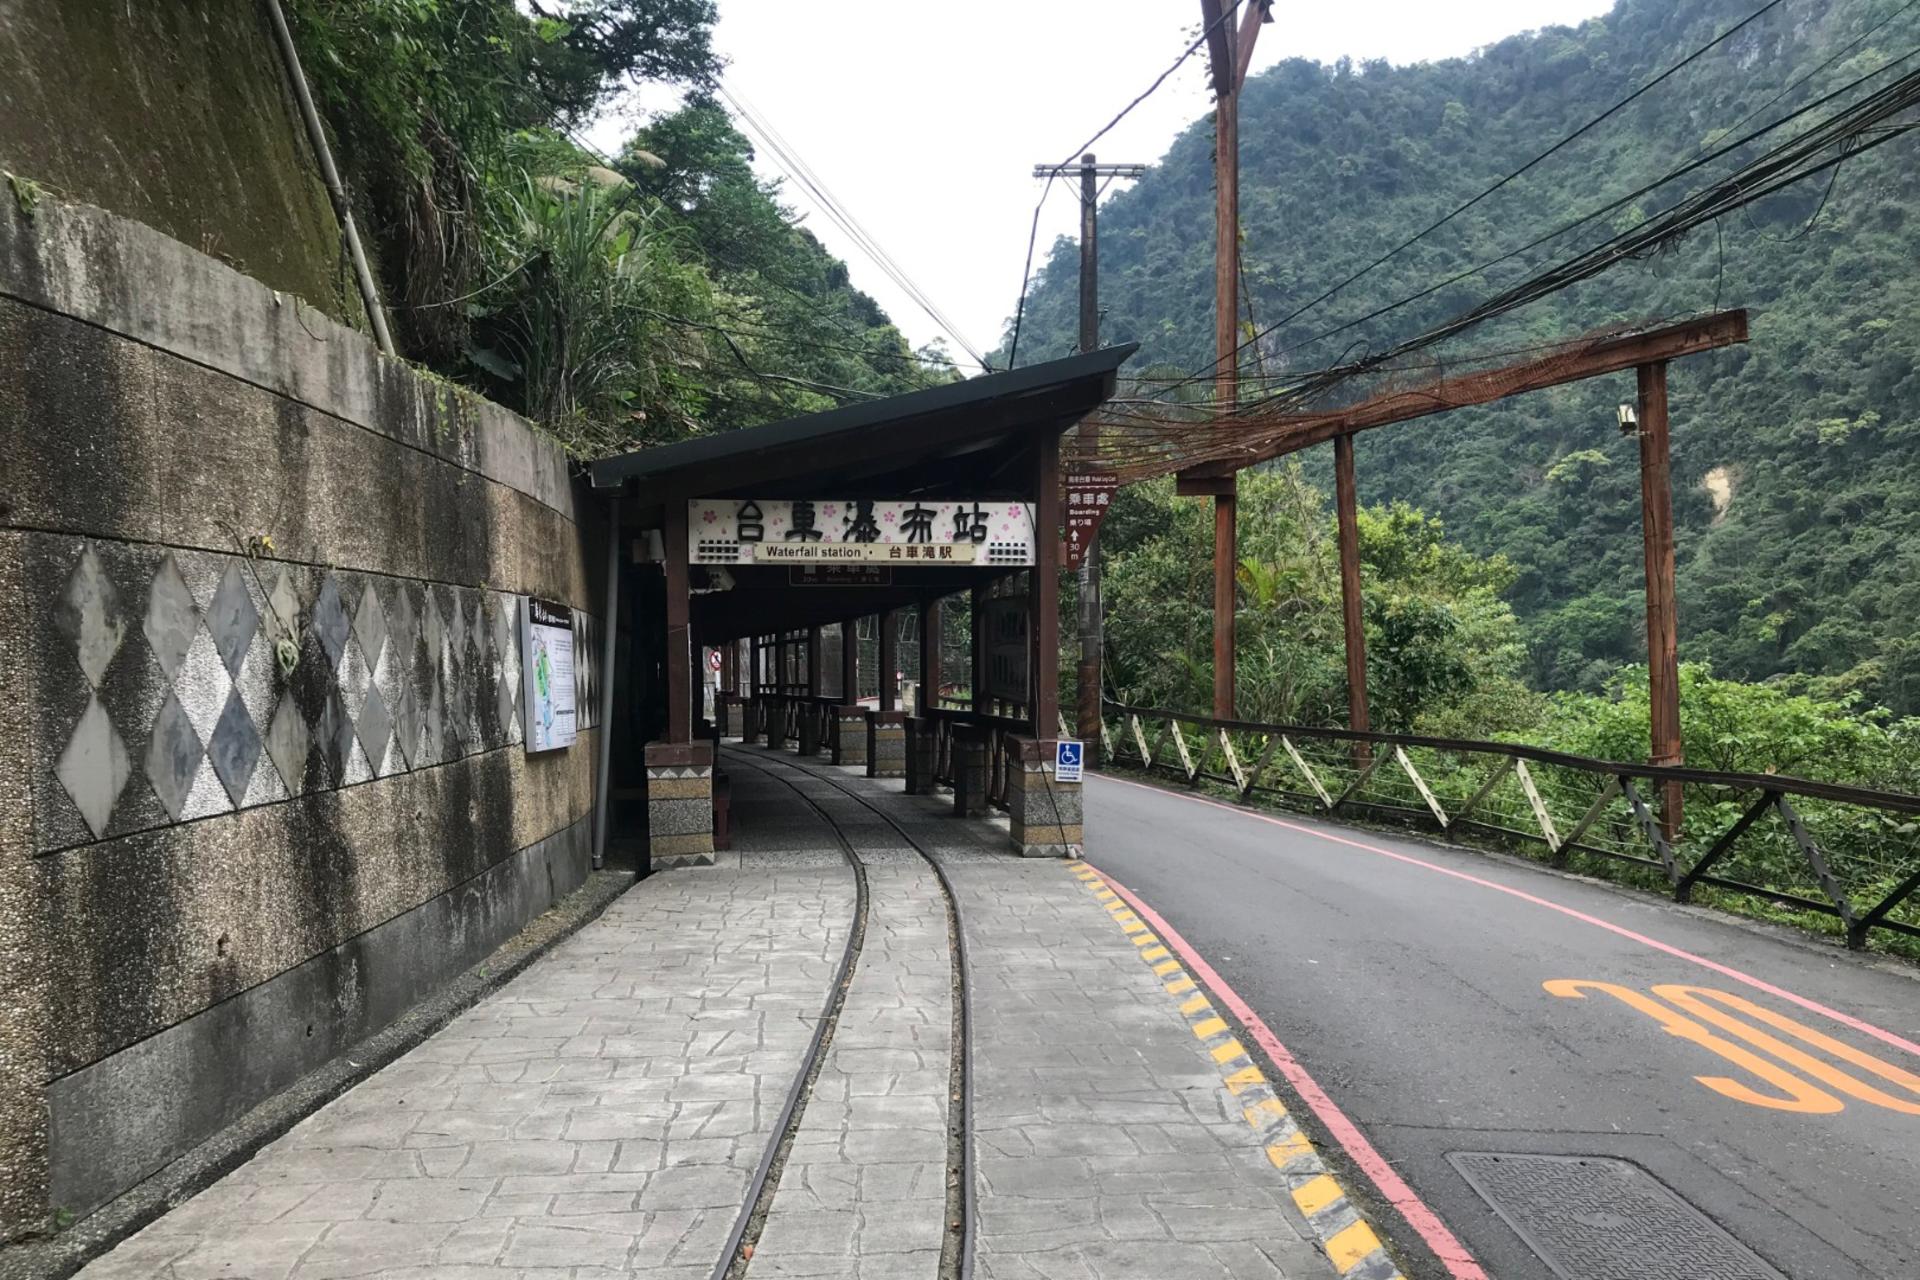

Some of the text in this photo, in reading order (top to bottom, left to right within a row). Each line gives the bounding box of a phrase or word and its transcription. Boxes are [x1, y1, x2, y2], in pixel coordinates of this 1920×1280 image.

[1069, 492, 1109, 505] 乘車處
[736, 500, 990, 543] 台車瀑布站
[766, 546, 952, 559] Waterfall station 台車滝駅
[1069, 543, 1080, 551] 30
[1542, 979, 1920, 1114] 30
